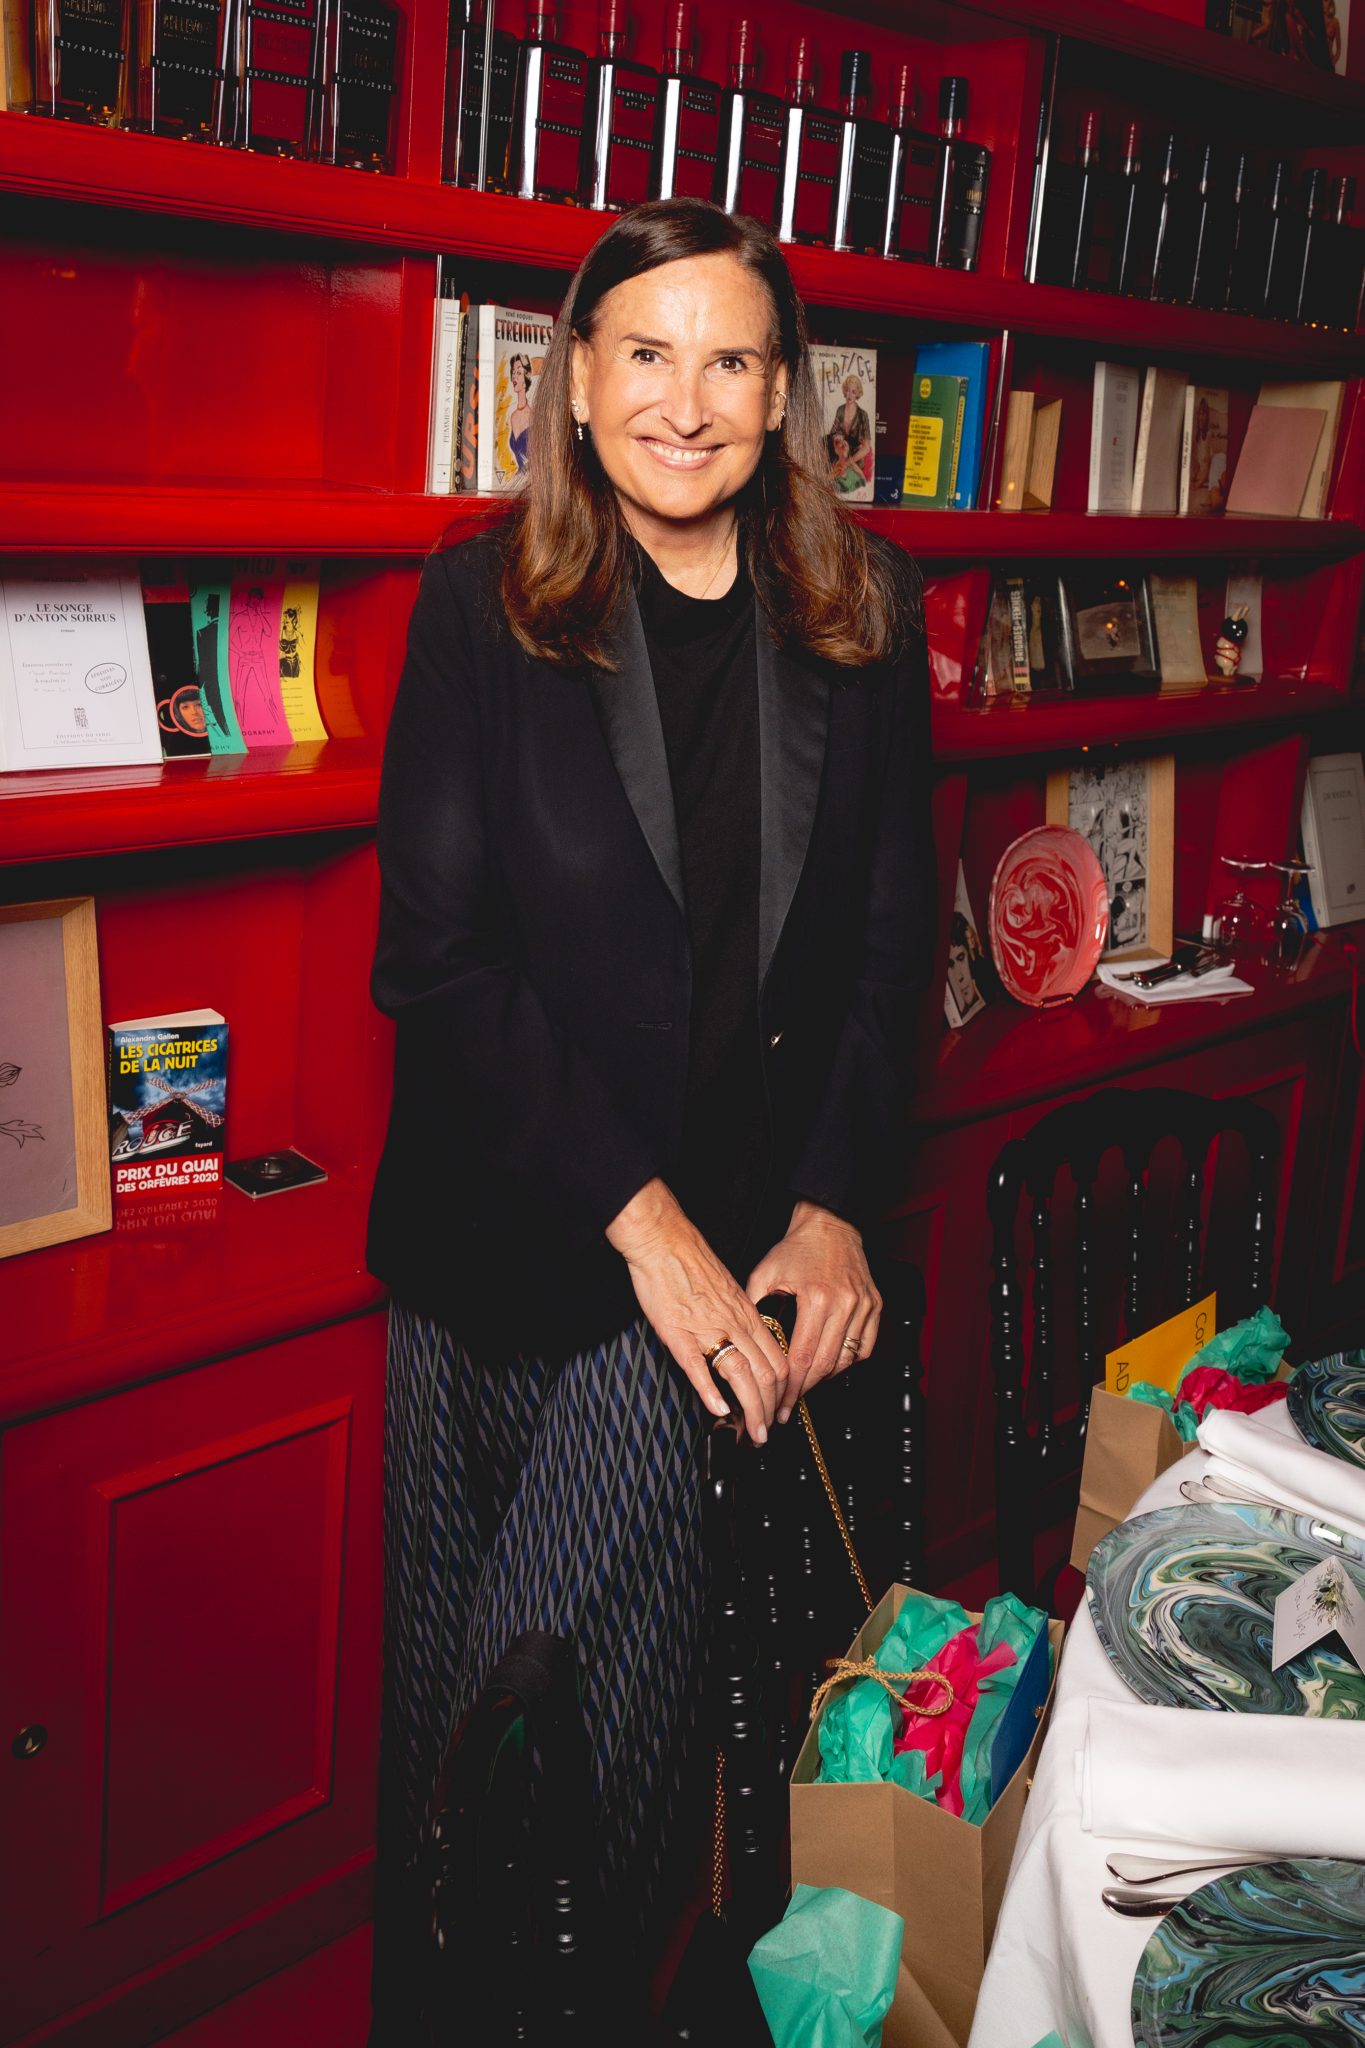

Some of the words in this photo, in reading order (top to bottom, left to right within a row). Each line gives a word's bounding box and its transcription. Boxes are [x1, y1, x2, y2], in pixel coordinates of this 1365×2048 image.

[496, 318, 554, 346] ETREINTES
[36, 602, 53, 613] LE
[53, 602, 94, 613] SONGE
[1010, 590, 1022, 620] FEMMES
[14, 613, 67, 623] D'ANTON
[70, 613, 116, 623] SORRUS
[1012, 625, 1024, 662] BRIGADES
[120, 1035, 156, 1044] Alexandre
[120, 1045, 144, 1059] LES
[147, 1039, 218, 1057] CICATRICES
[120, 1060, 140, 1075] DE
[143, 1058, 160, 1072] LA
[164, 1055, 199, 1070] NUIT
[112, 1120, 194, 1156] ROUGE
[194, 1140, 213, 1150] fayard
[117, 1166, 152, 1182] PRIX
[155, 1162, 178, 1176] DU
[182, 1158, 219, 1173] QUAI
[116, 1182, 136, 1193] DES
[138, 1175, 190, 1191] ORFÈVRES
[193, 1172, 219, 1184] 2020
